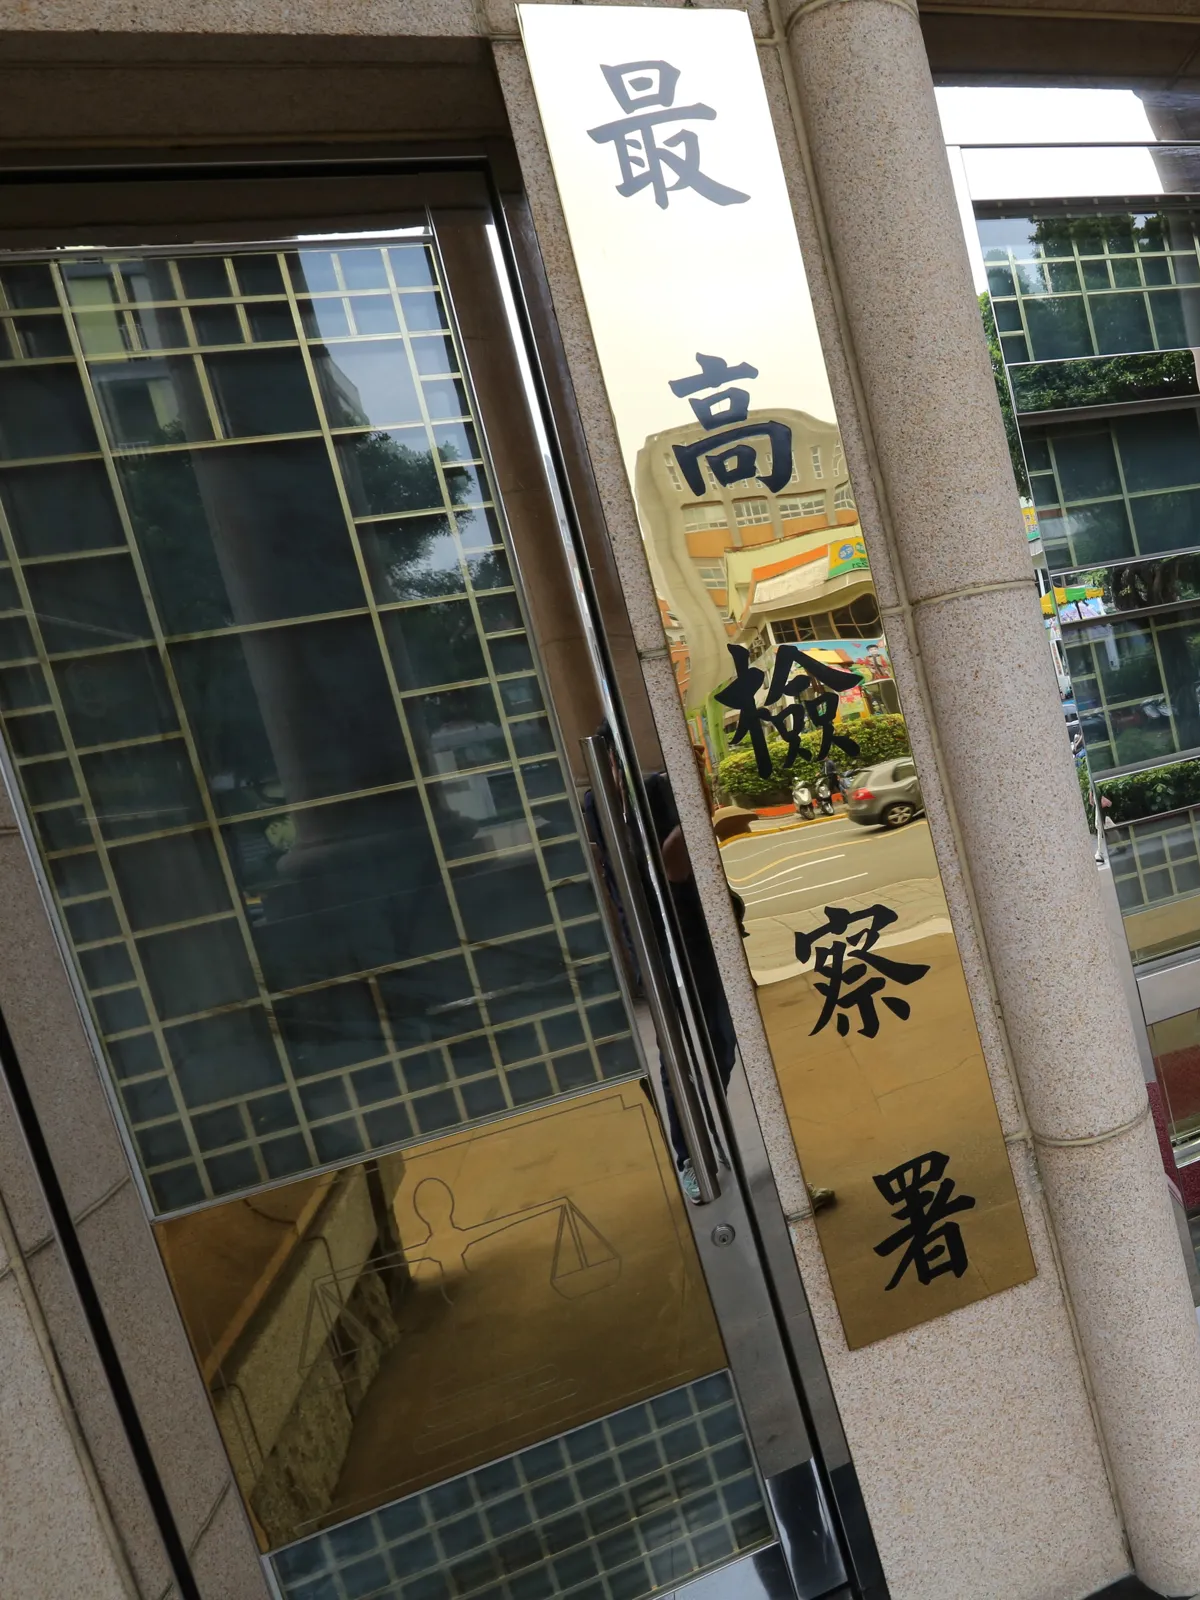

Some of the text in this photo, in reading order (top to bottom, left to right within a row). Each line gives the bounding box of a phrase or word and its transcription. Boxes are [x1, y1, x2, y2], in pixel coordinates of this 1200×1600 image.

[587, 59, 976, 1292] 最高檢察署
